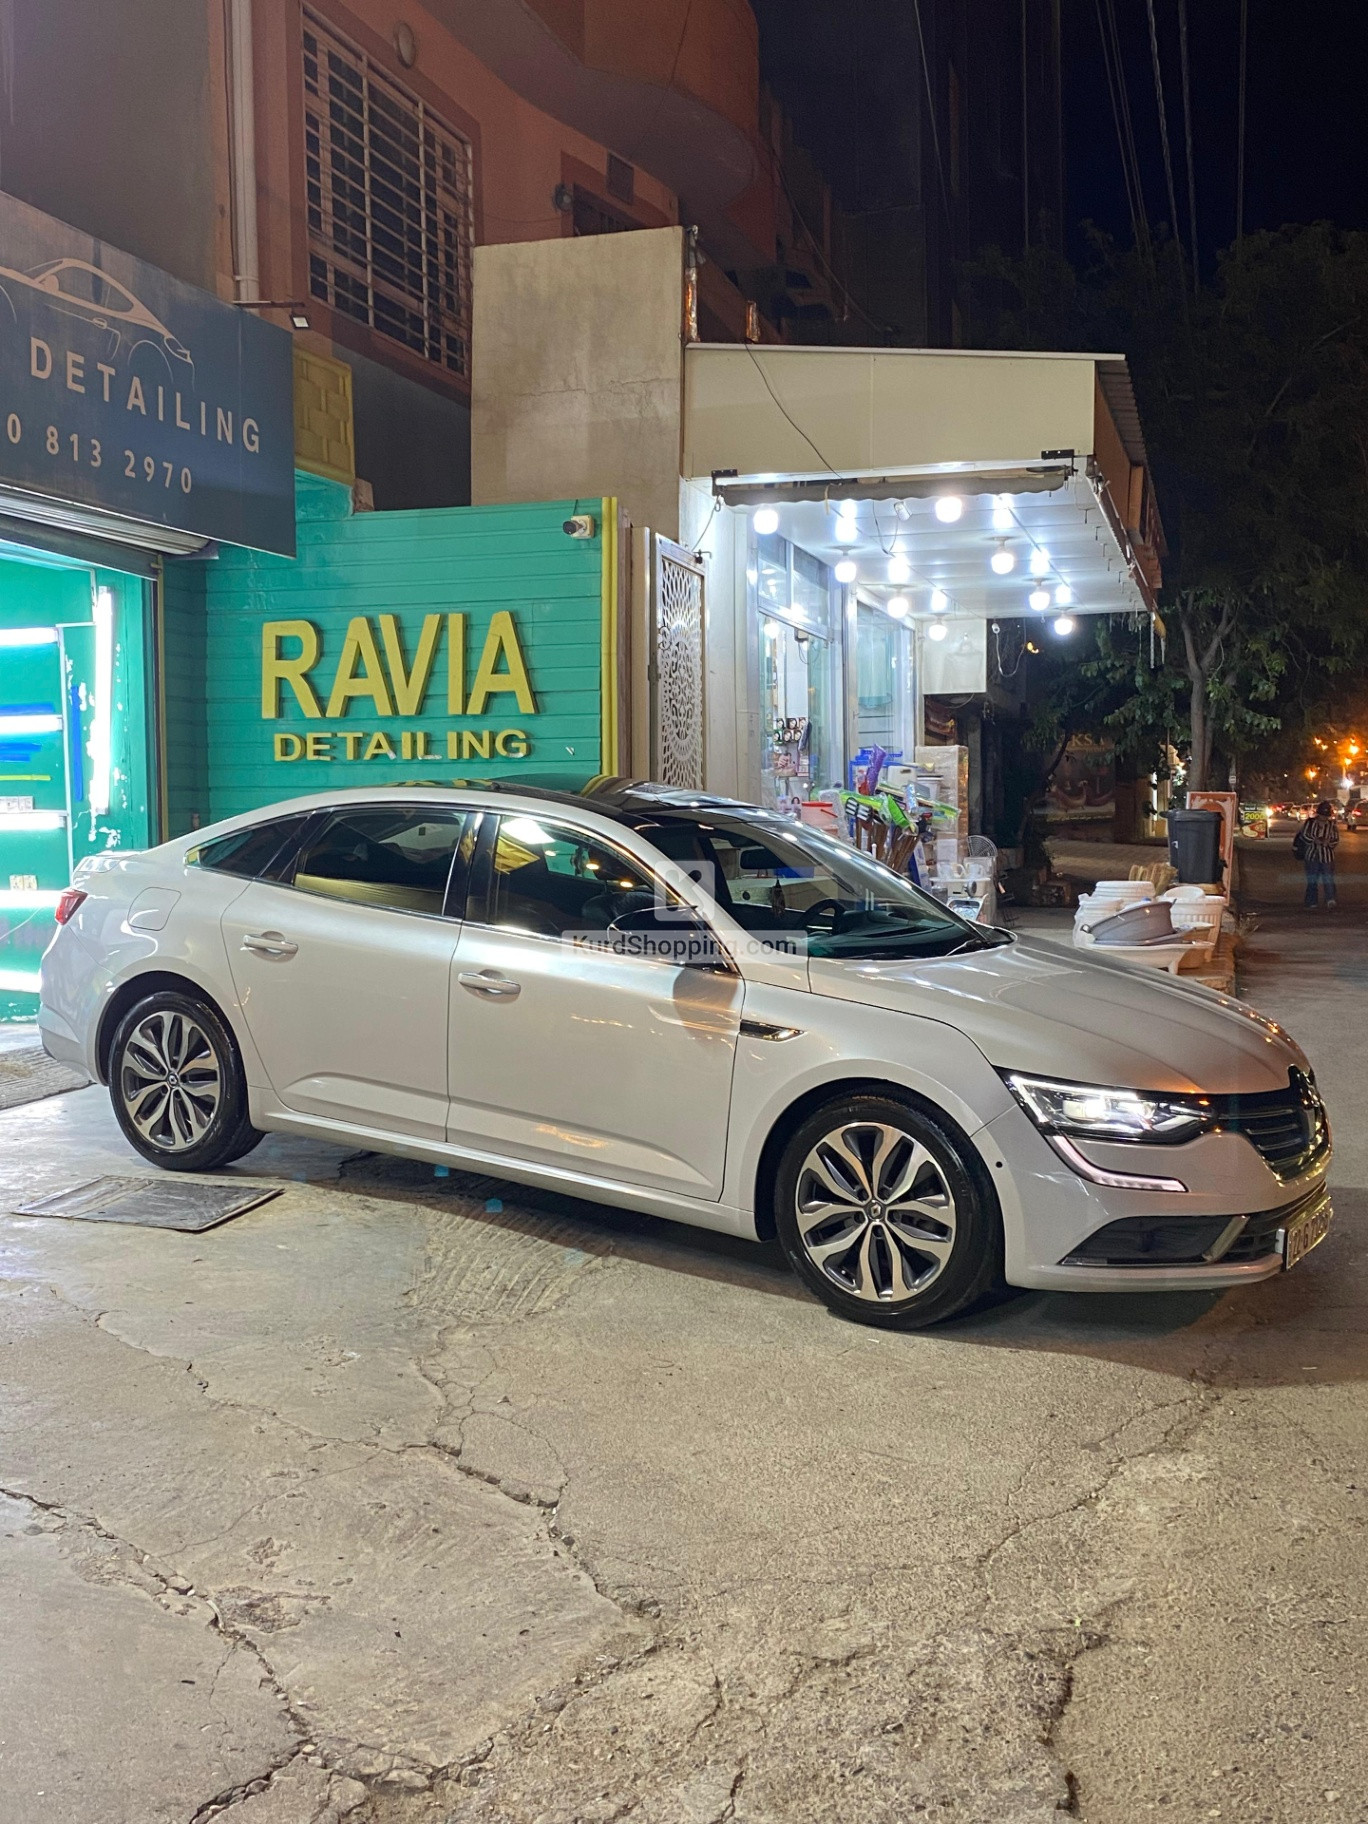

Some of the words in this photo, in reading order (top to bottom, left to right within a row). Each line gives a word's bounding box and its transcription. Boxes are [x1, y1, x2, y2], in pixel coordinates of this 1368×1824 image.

[30, 336, 260, 454] DETAILING
[46, 425, 102, 467] 813
[124, 450, 192, 494] 2970
[261, 610, 539, 719] RAVIA
[274, 728, 531, 762] DETAILING
